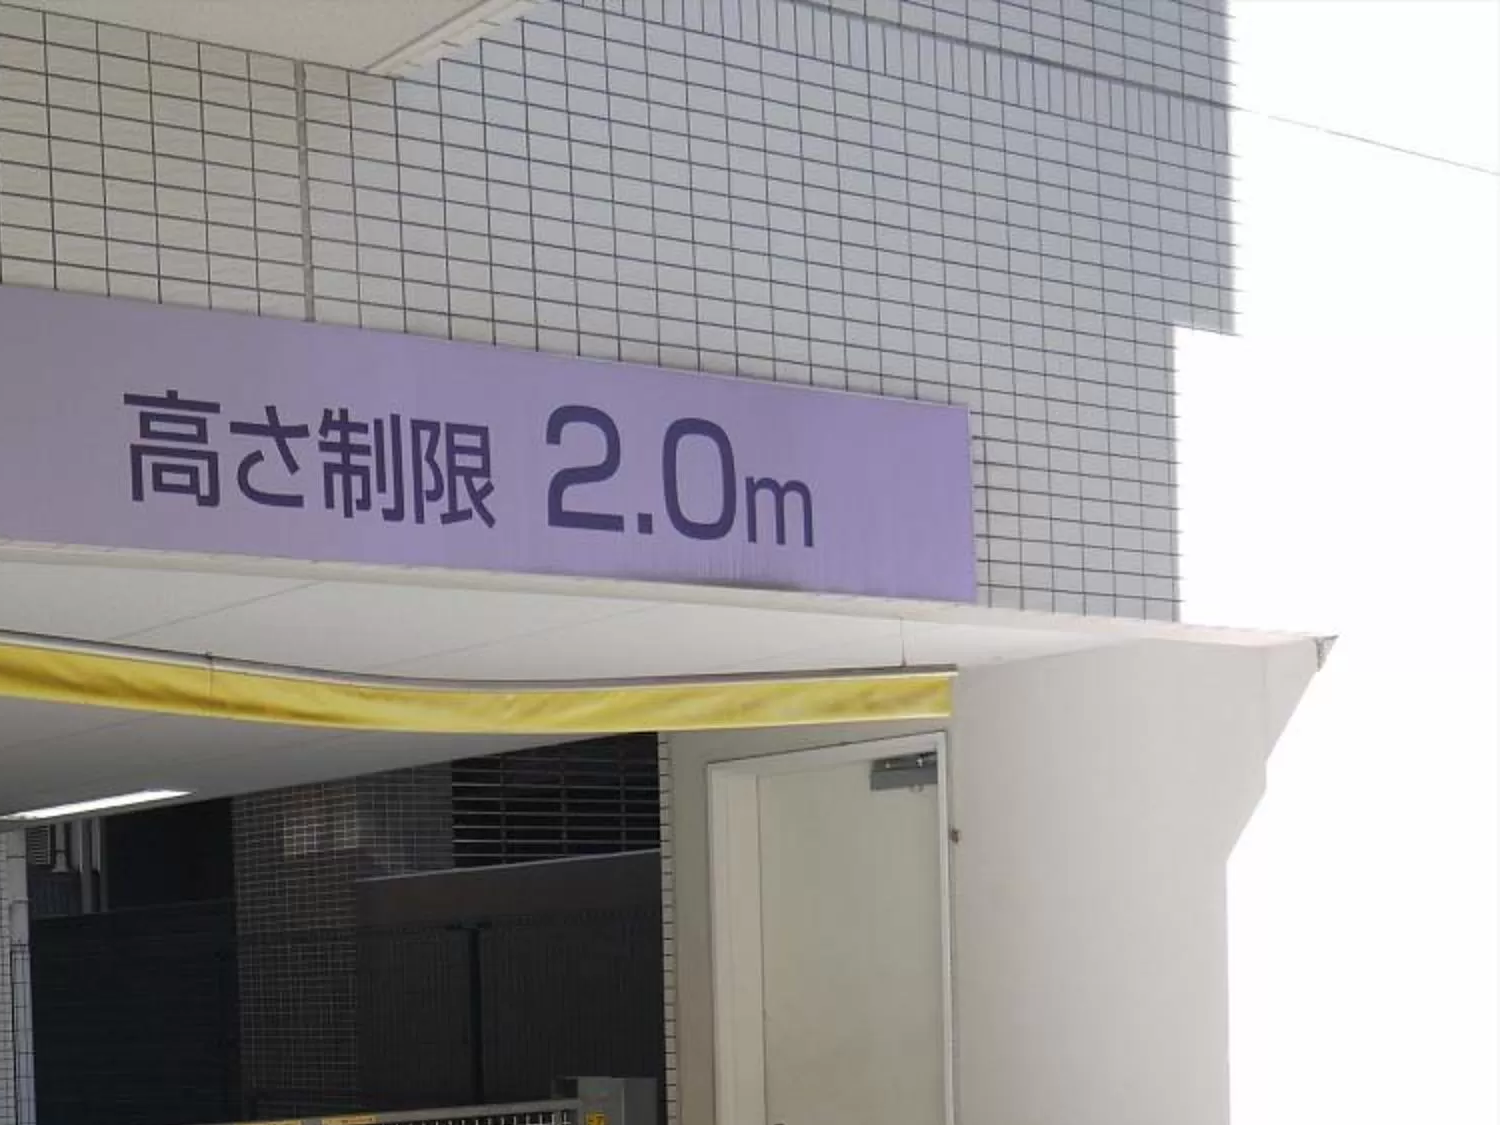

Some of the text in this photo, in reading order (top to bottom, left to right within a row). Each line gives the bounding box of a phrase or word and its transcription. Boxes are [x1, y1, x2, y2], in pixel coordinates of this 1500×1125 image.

[122, 388, 817, 549] 高さ制限 2.0m
